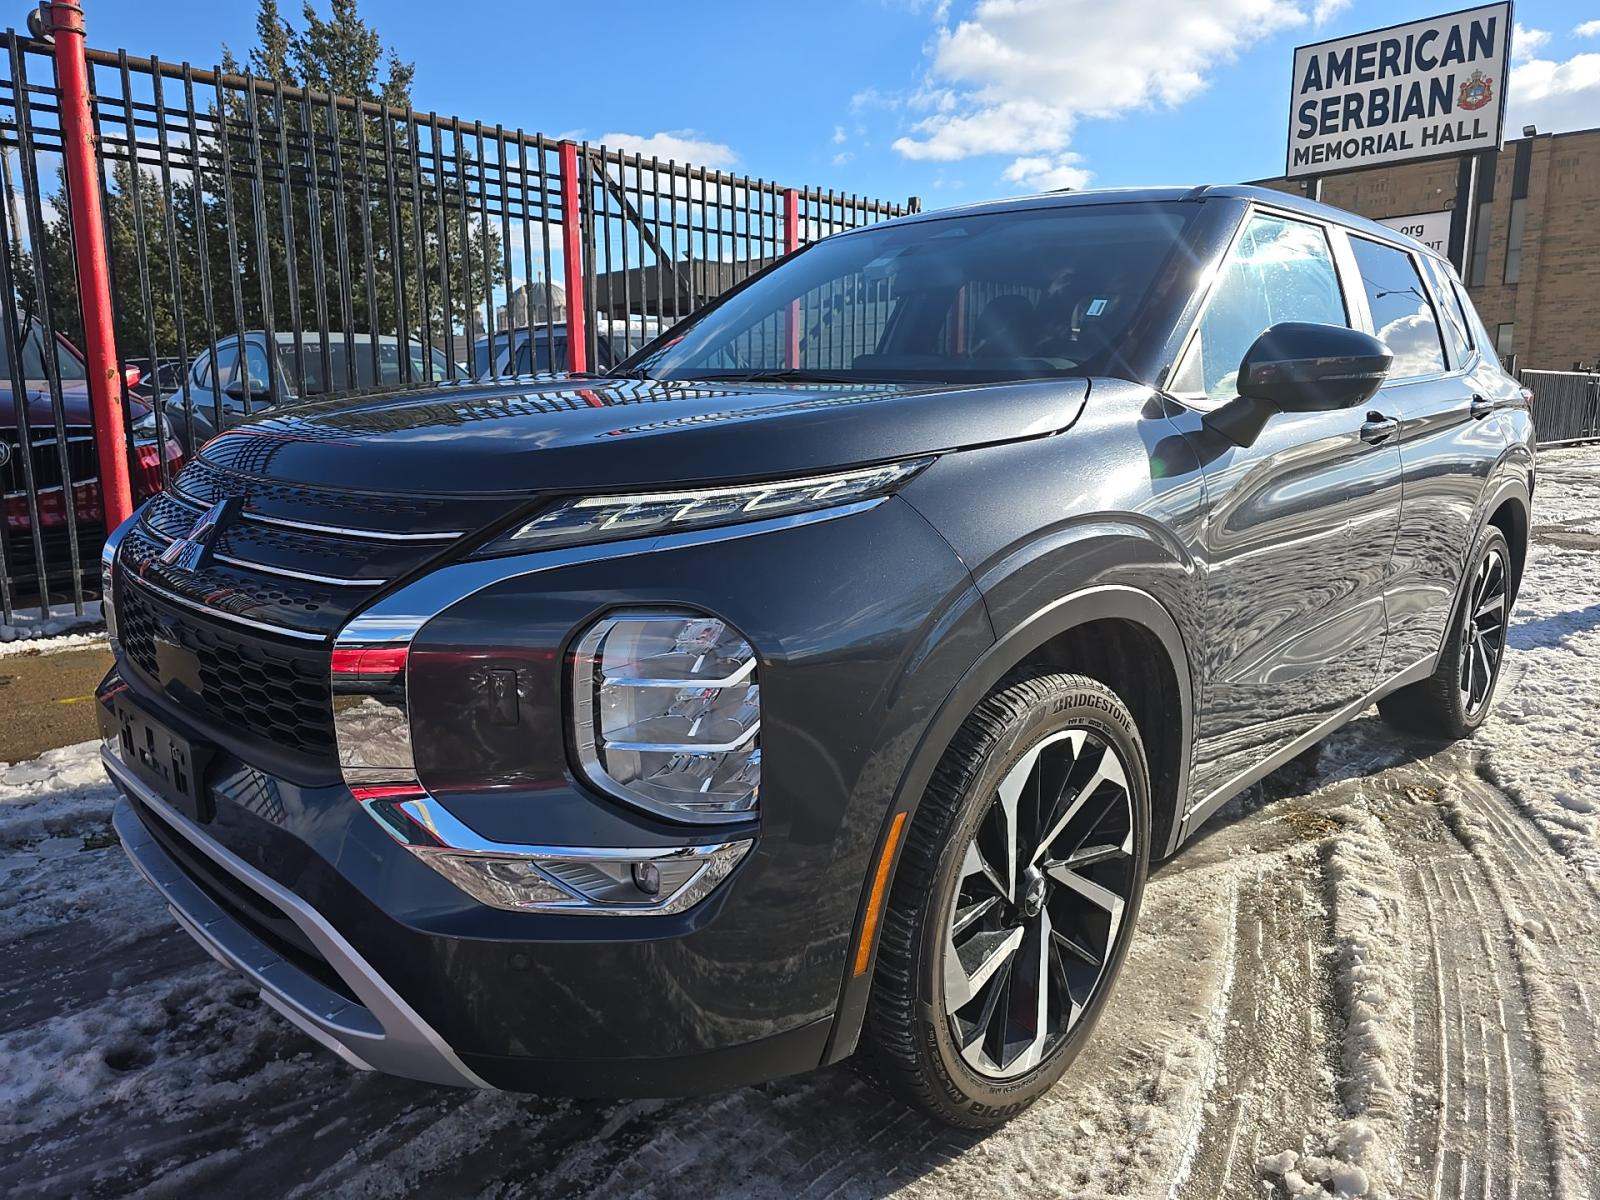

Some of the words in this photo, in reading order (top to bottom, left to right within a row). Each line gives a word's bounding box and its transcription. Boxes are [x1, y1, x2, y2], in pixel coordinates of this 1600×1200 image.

[1300, 17, 1497, 95] AMERICAN
[1296, 74, 1455, 140] SERBIAN
[1293, 130, 1414, 167] MEMORIAL
[1421, 118, 1488, 147] HALL
[1052, 693, 1132, 733] BRIDGESTONE
